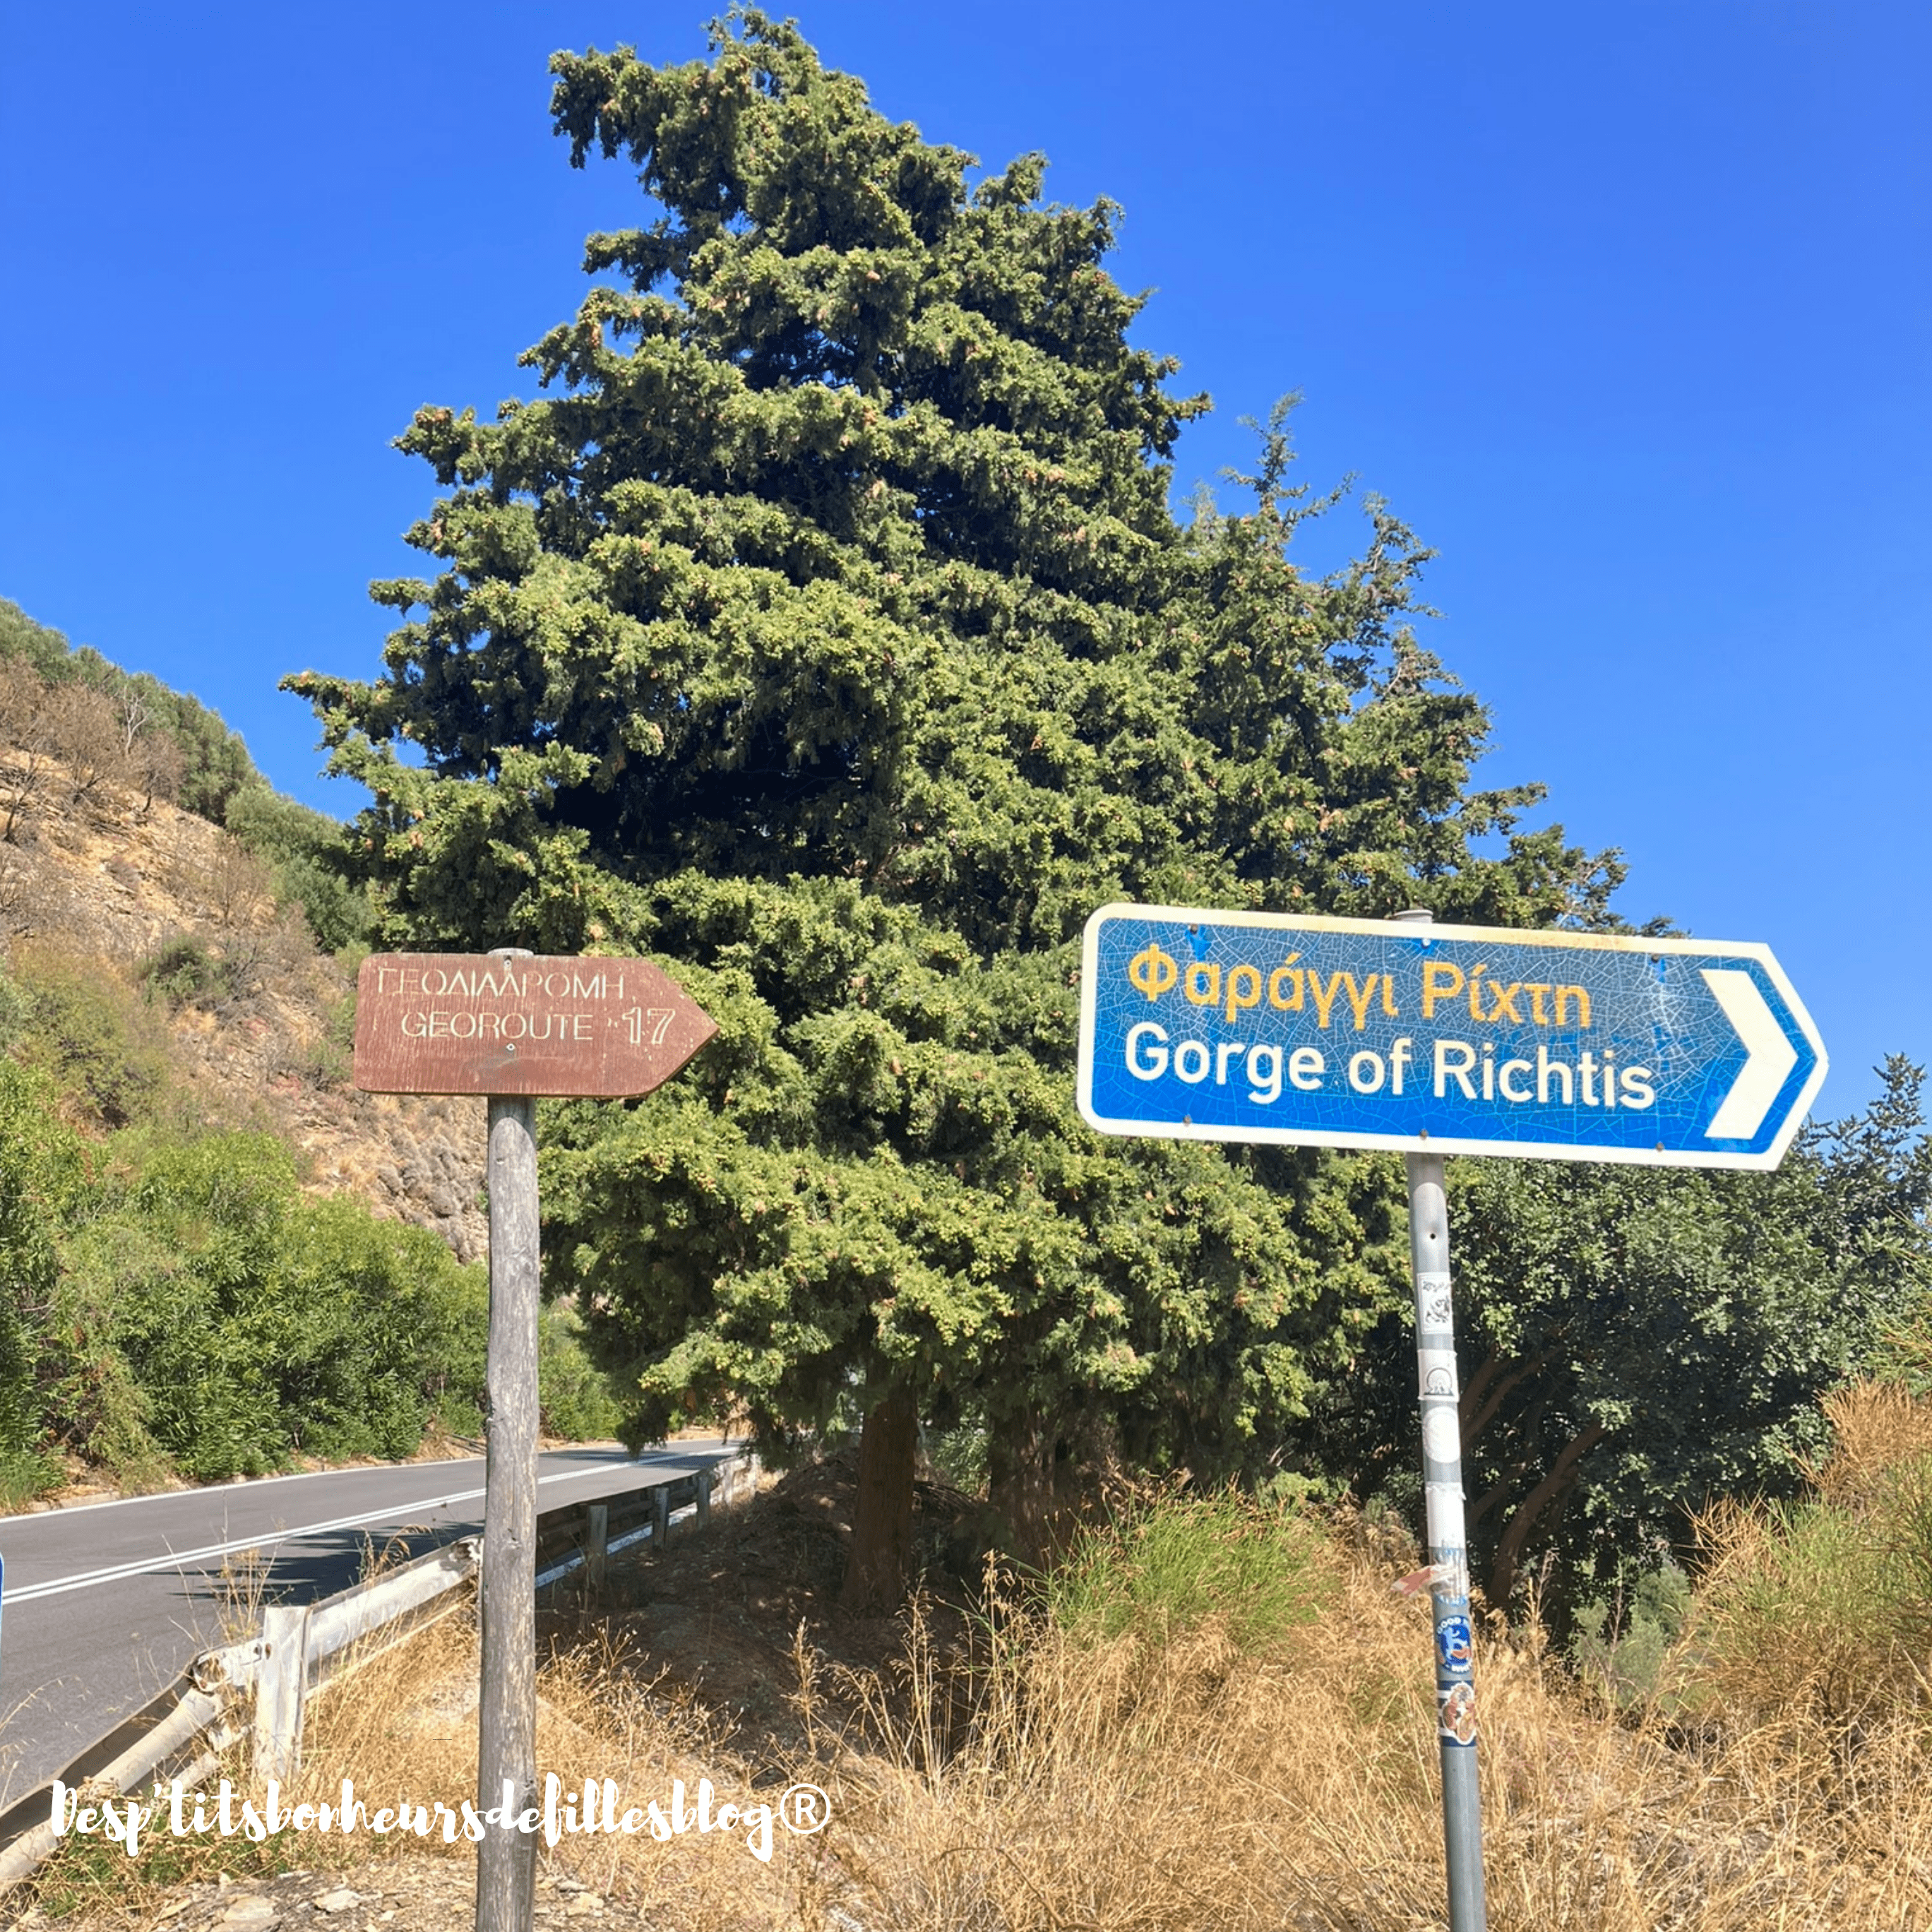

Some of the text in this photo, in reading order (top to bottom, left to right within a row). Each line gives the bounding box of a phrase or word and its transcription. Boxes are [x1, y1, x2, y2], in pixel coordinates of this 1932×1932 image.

[401, 1006, 676, 1045] GEOROUTE 17
[1128, 943, 1590, 1030] Φαράγγι Ρίχτη
[1126, 1022, 1655, 1109] Gorge of Richtis
